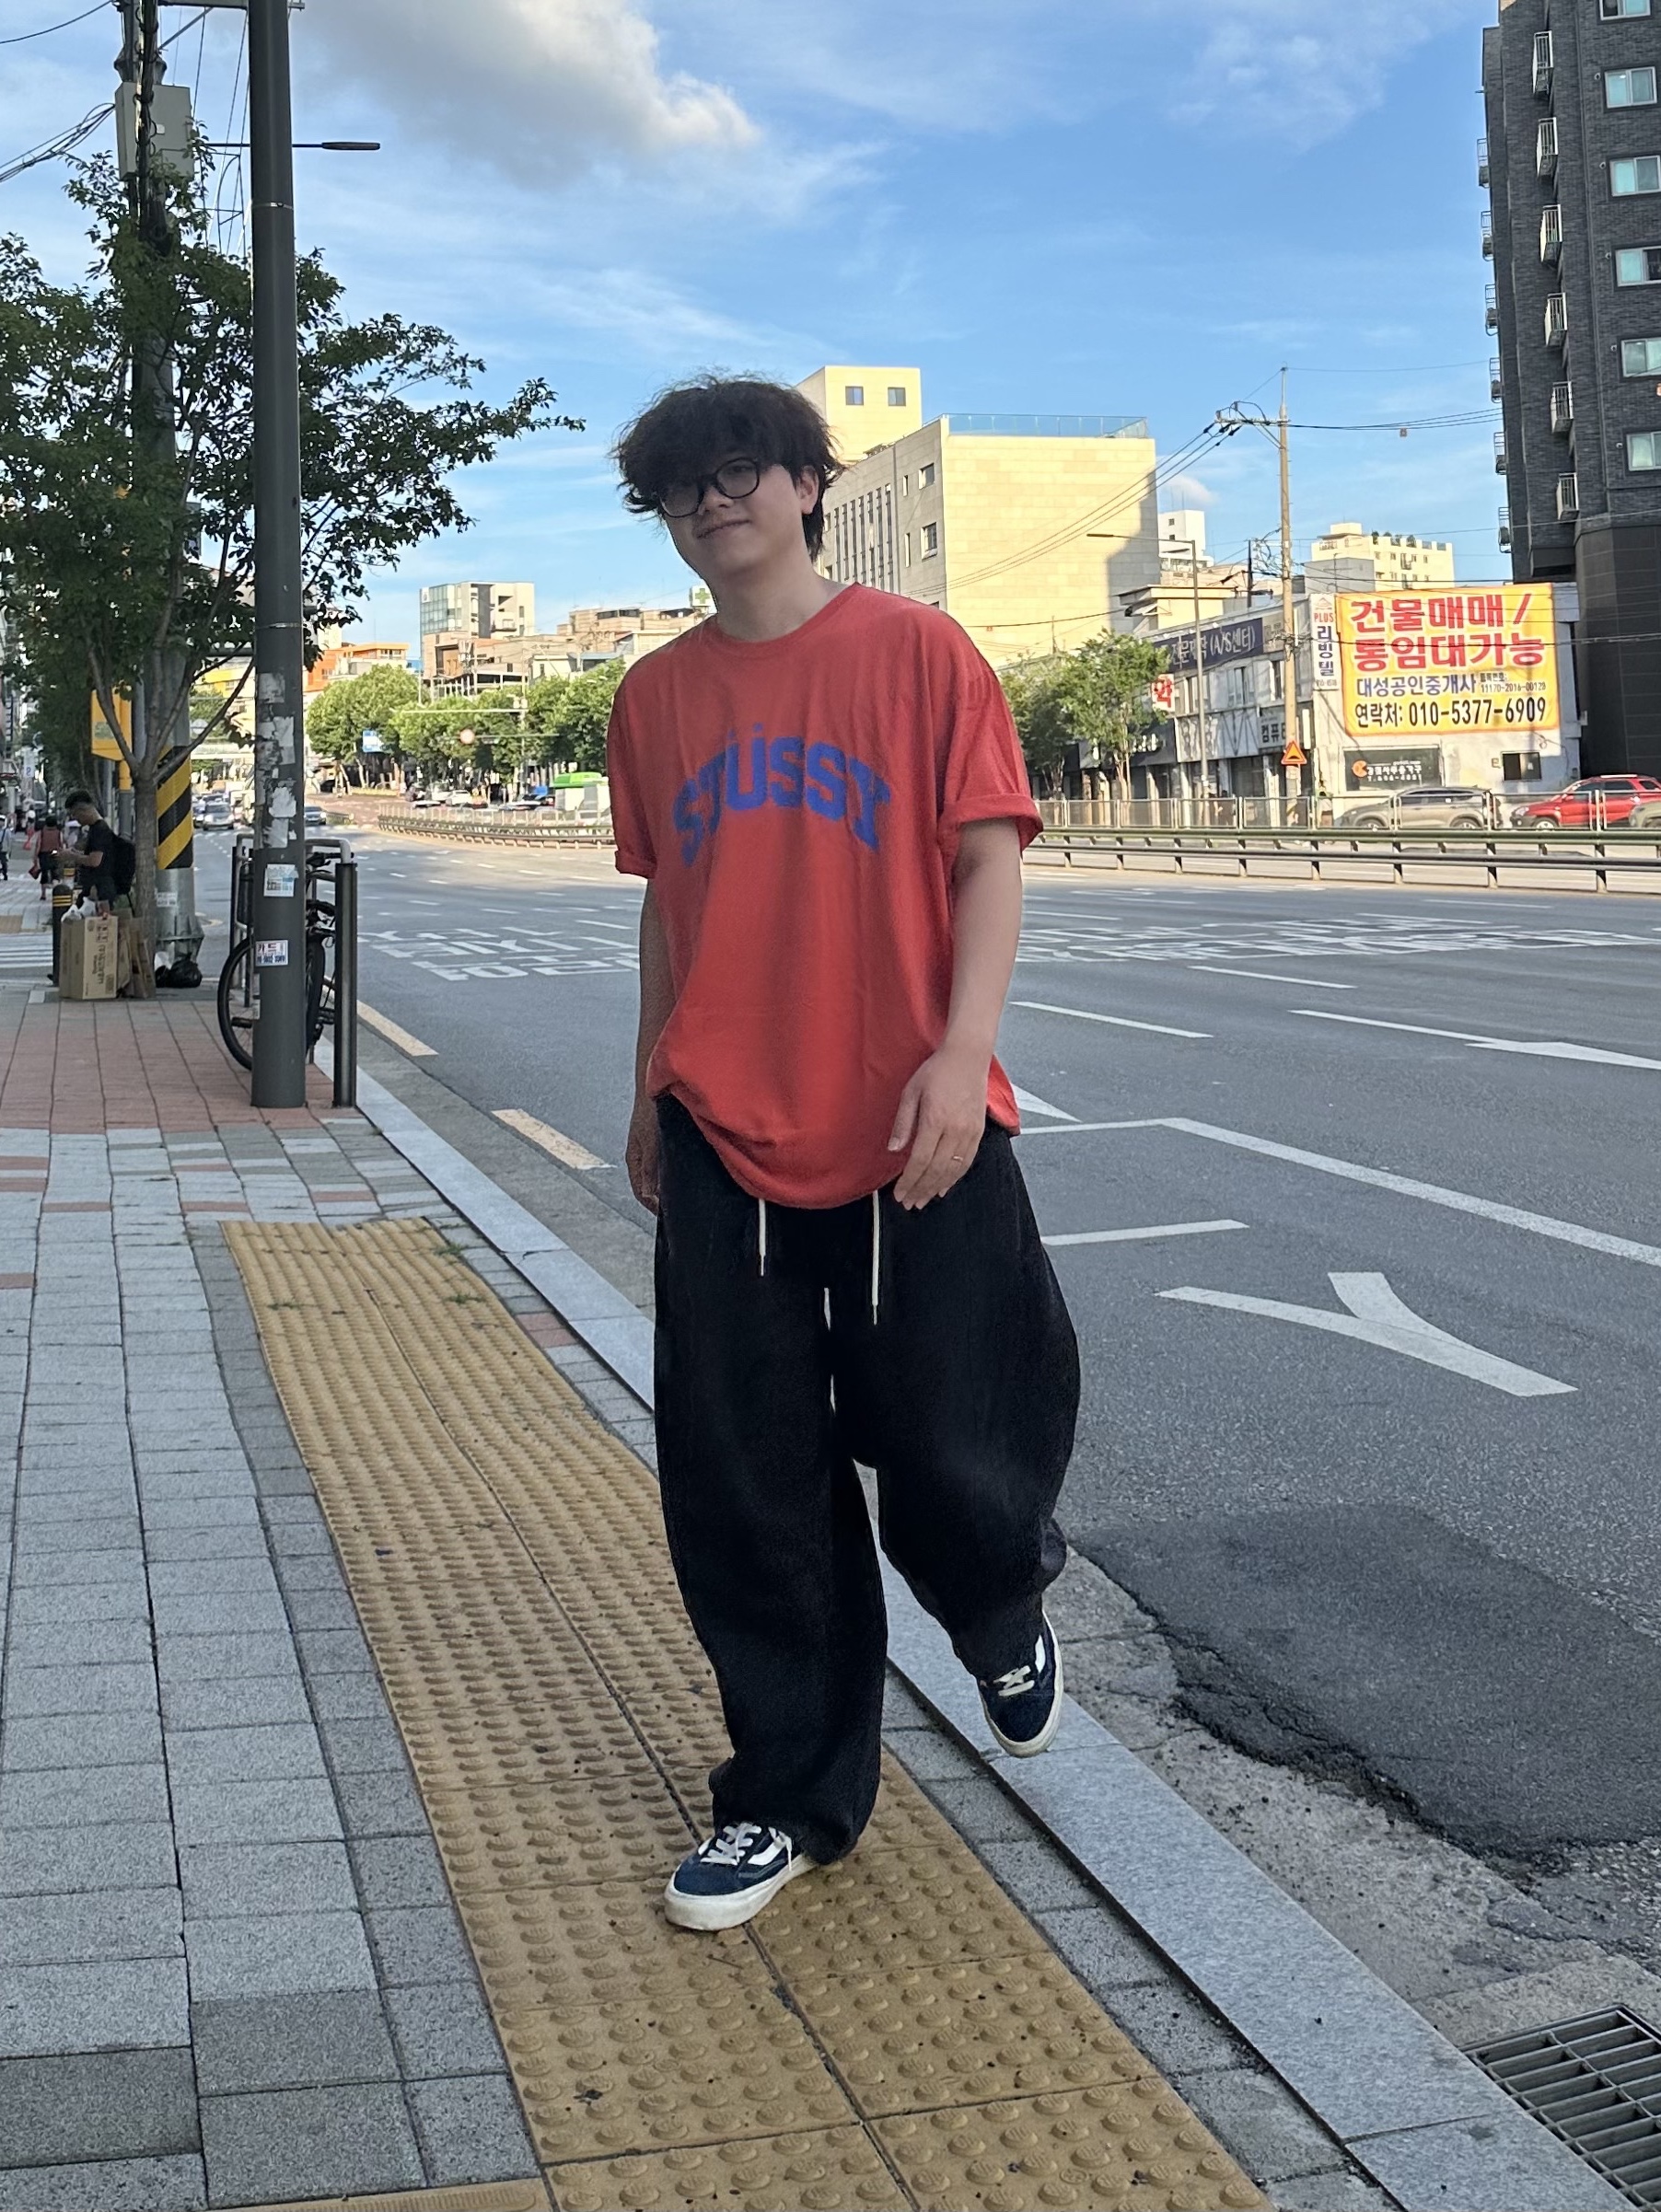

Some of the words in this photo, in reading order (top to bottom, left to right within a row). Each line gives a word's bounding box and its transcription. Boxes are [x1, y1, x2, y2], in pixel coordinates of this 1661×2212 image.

[1313, 612, 1334, 623] PLUS
[1353, 632, 1546, 672] 통임대가능
[1356, 673, 1477, 698] 대성공인중개사
[1355, 702, 1403, 729] 연락처:
[1408, 696, 1547, 727] 010-5377-6909
[673, 723, 891, 868] STÜSSY
